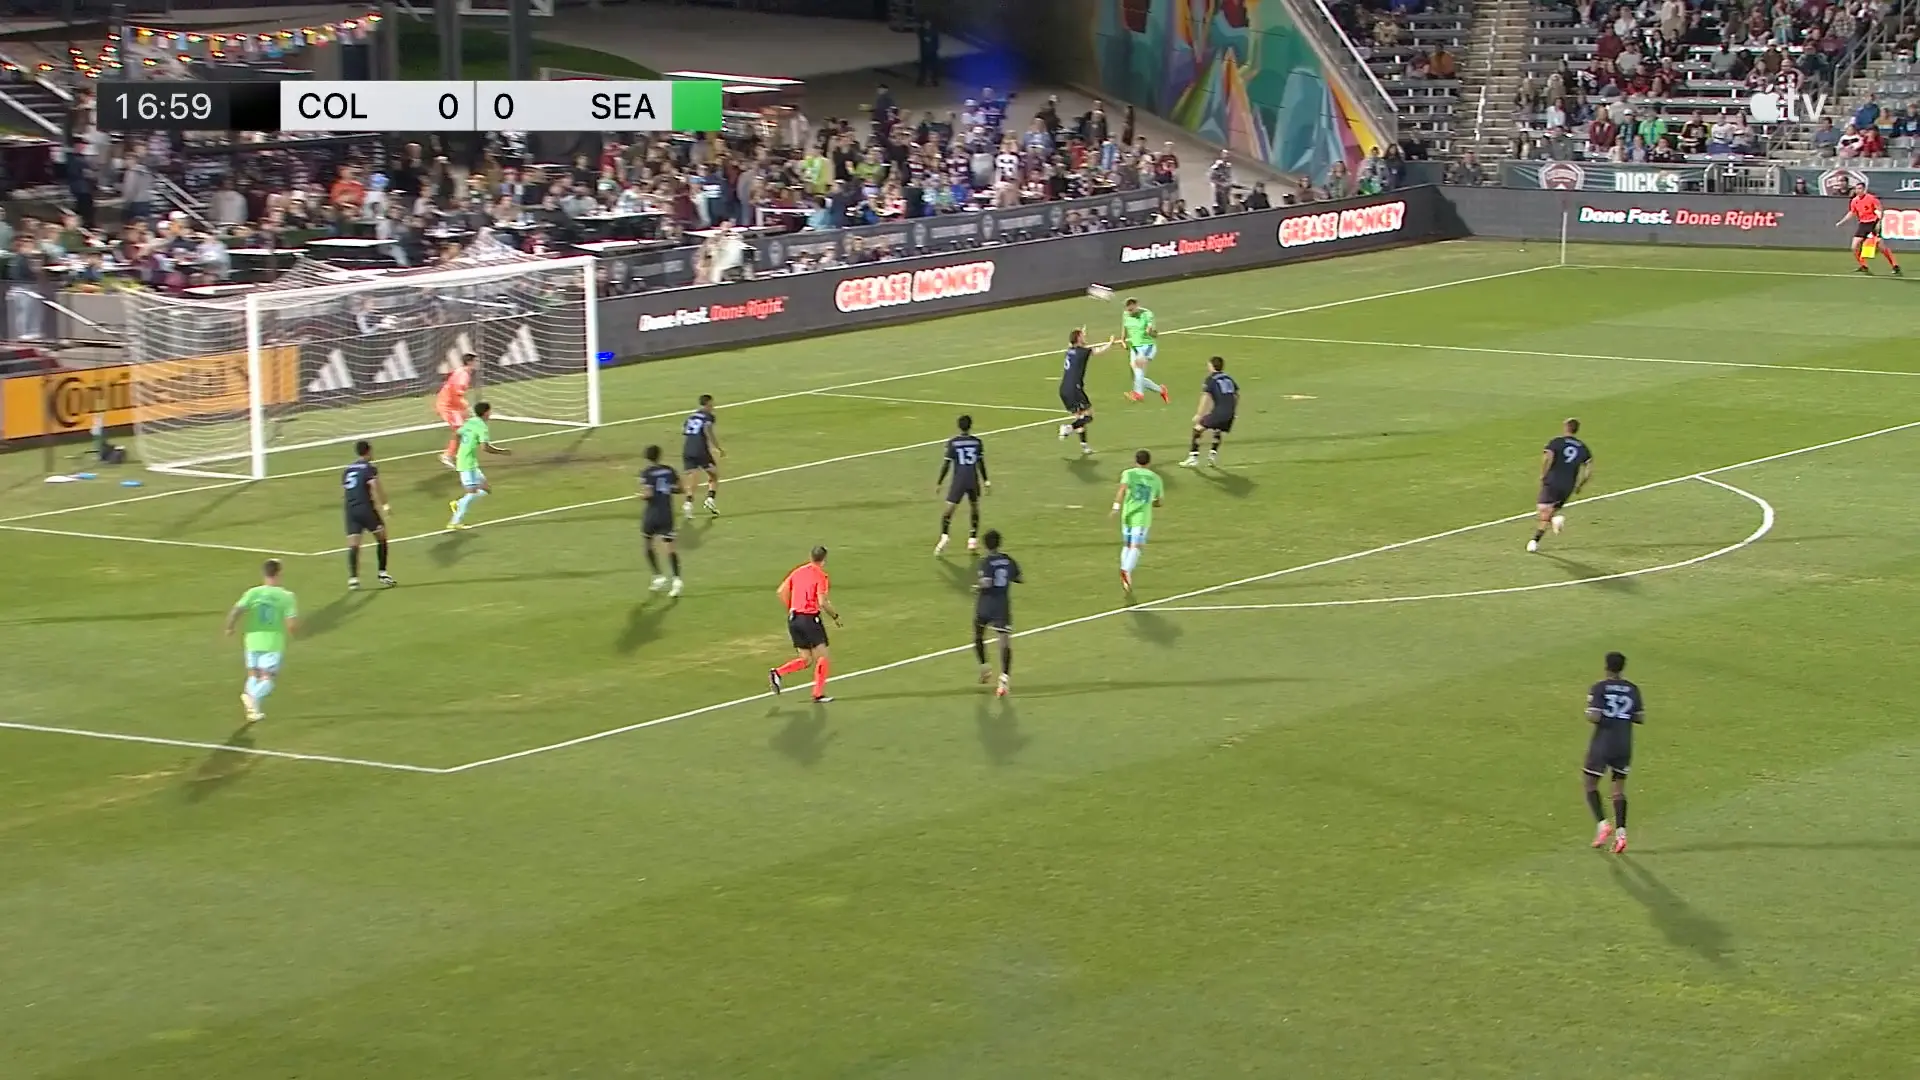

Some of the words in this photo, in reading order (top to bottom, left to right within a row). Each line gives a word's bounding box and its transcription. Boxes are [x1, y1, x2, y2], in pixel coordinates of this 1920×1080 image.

[1615, 172, 1679, 192] DICKS
[1279, 212, 1339, 247] GREASE
[1339, 201, 1405, 239] MONKEY
[1580, 207, 1627, 223] Done
[1627, 208, 1672, 224] Fast.
[1675, 210, 1721, 225] Done
[836, 272, 912, 312] GREASE
[912, 261, 995, 301] MONKEY
[955, 447, 977, 465] 13
[1563, 446, 1578, 463] 9
[344, 471, 358, 490] 5
[1602, 694, 1632, 719] 32
